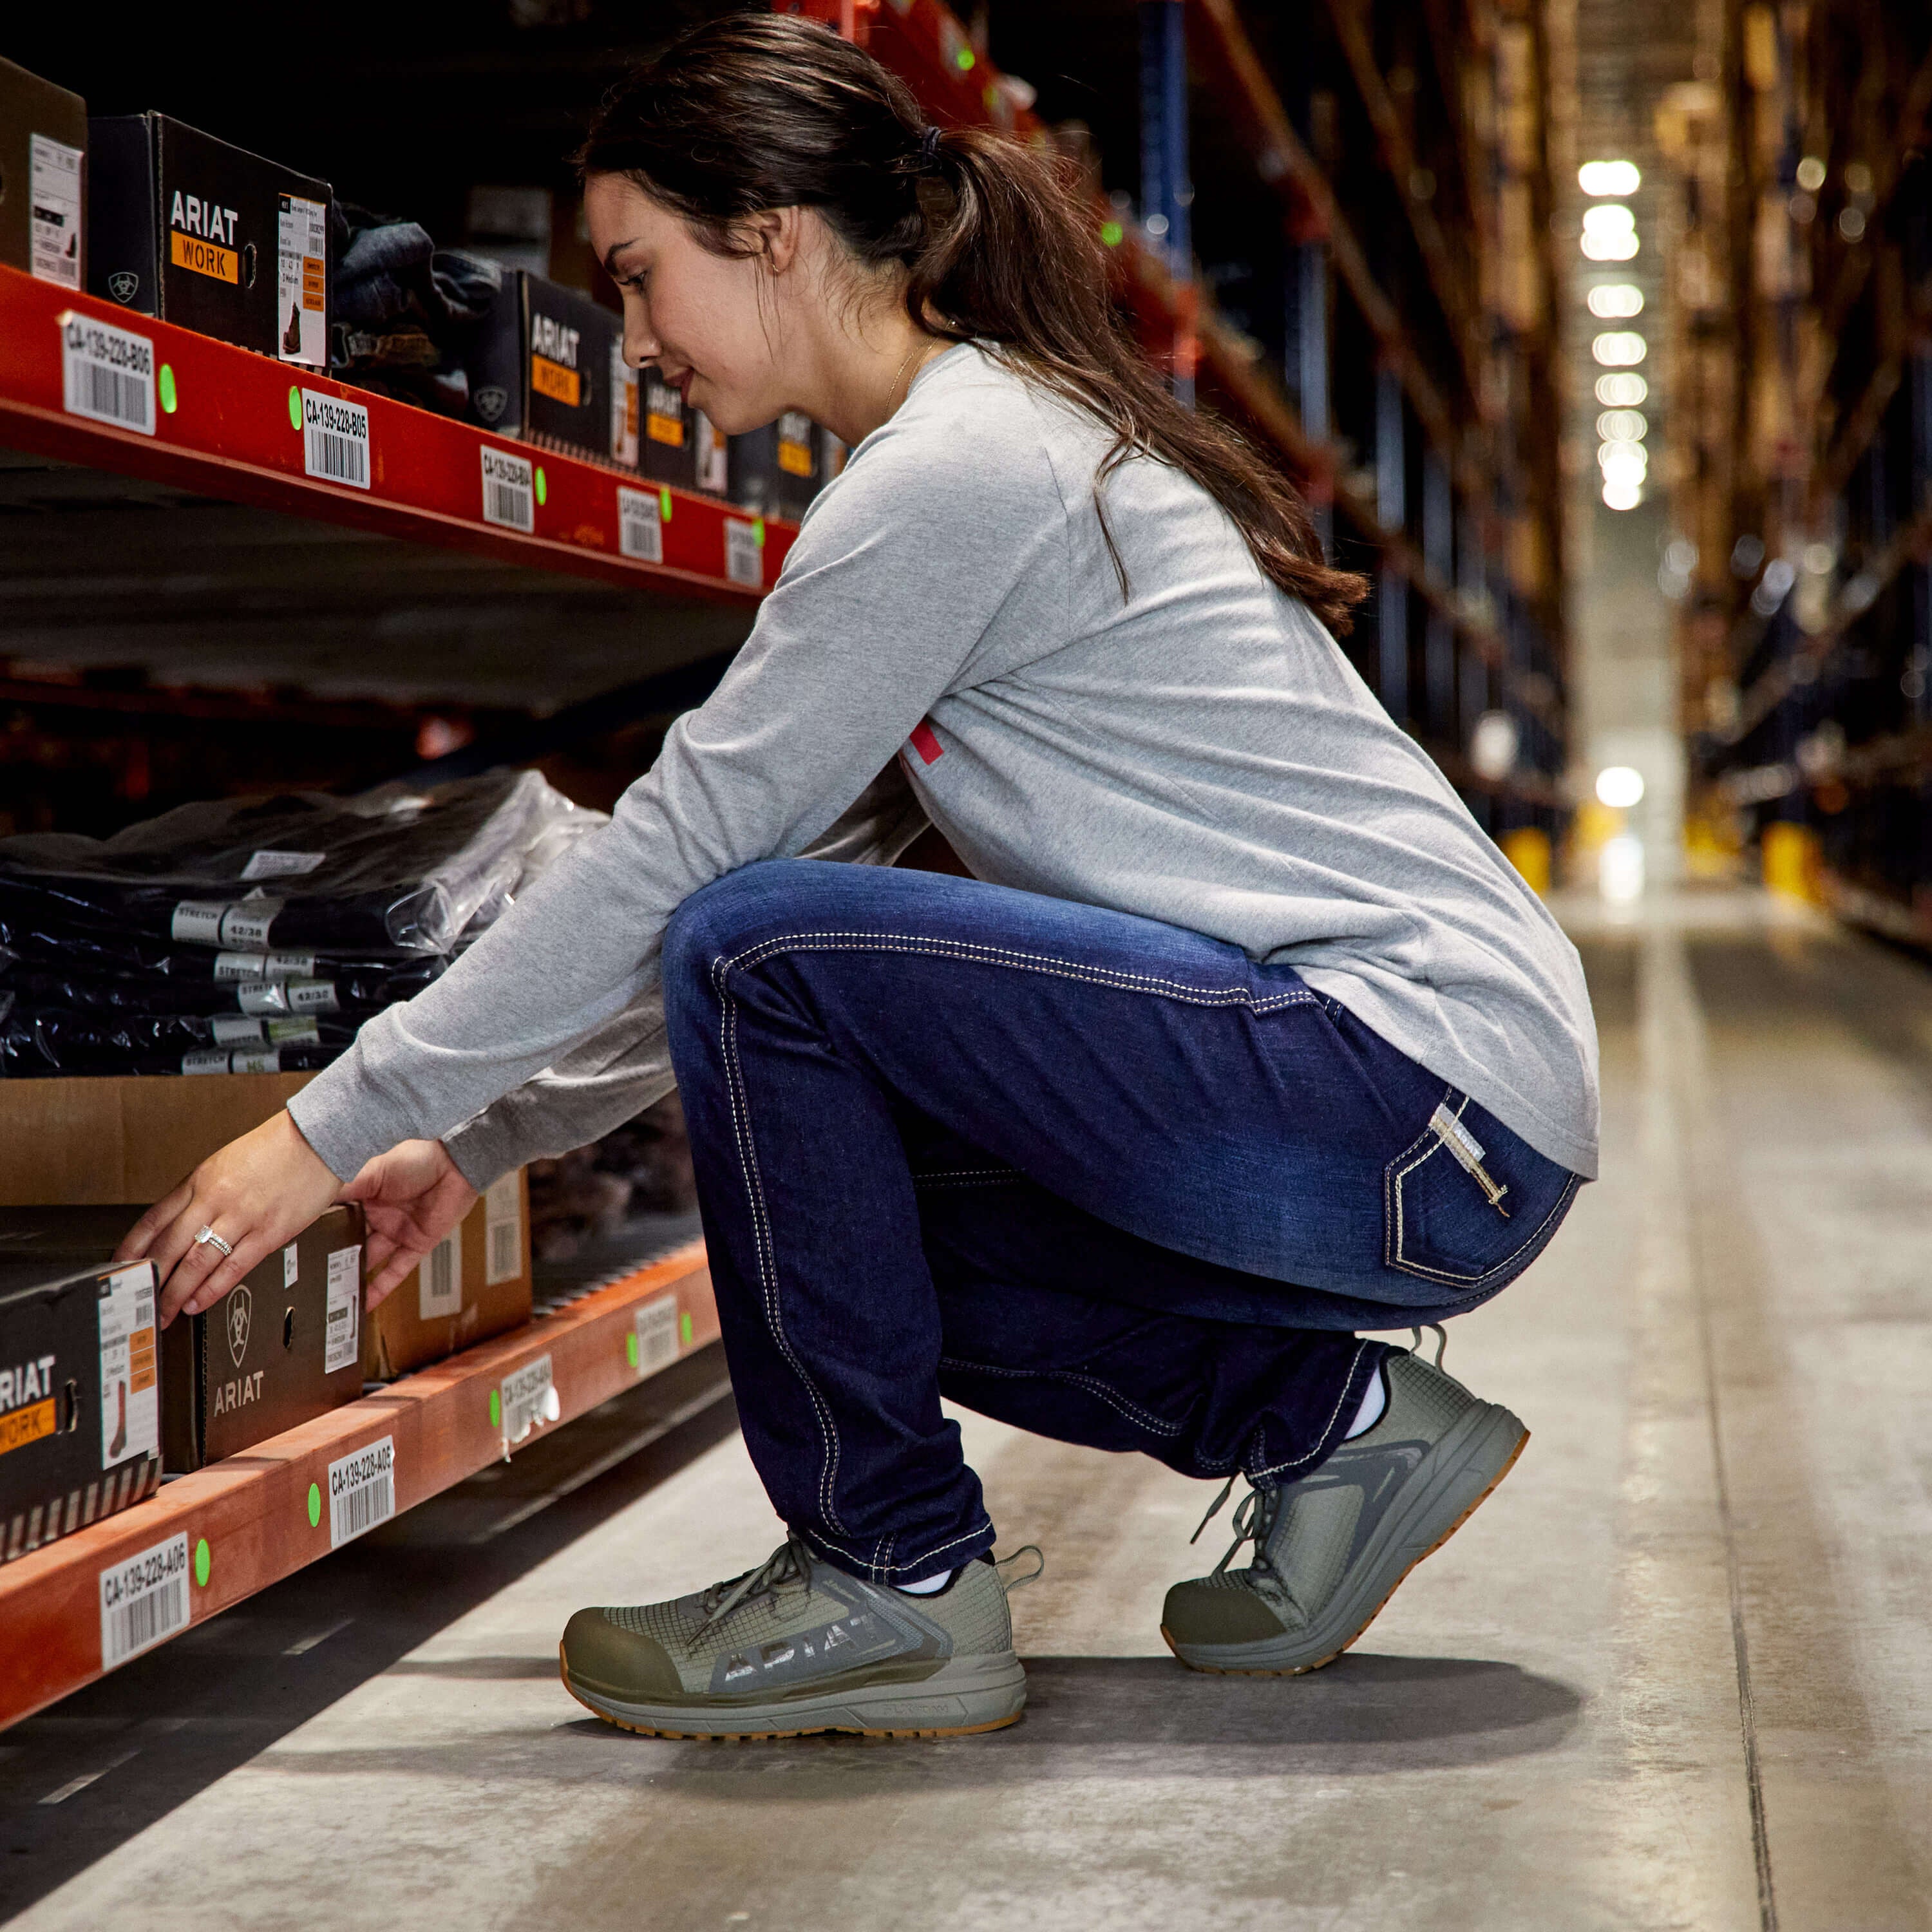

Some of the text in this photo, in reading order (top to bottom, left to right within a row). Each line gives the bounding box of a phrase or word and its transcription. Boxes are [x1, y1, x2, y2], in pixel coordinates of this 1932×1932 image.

[170, 190, 238, 246] ARIAT
[183, 240, 225, 276] WORK
[532, 312, 579, 369] ARIAT
[306, 398, 366, 439] CA-139-228-B05
[178, 906, 218, 920] STRETCH
[0, 1355, 55, 1414] RIAT
[214, 1370, 264, 1417] ARIAT
[0, 1408, 42, 1444] ORK
[332, 1444, 392, 1496] CA-139-228-A05
[104, 1542, 185, 1607] CA-139-228-A06
